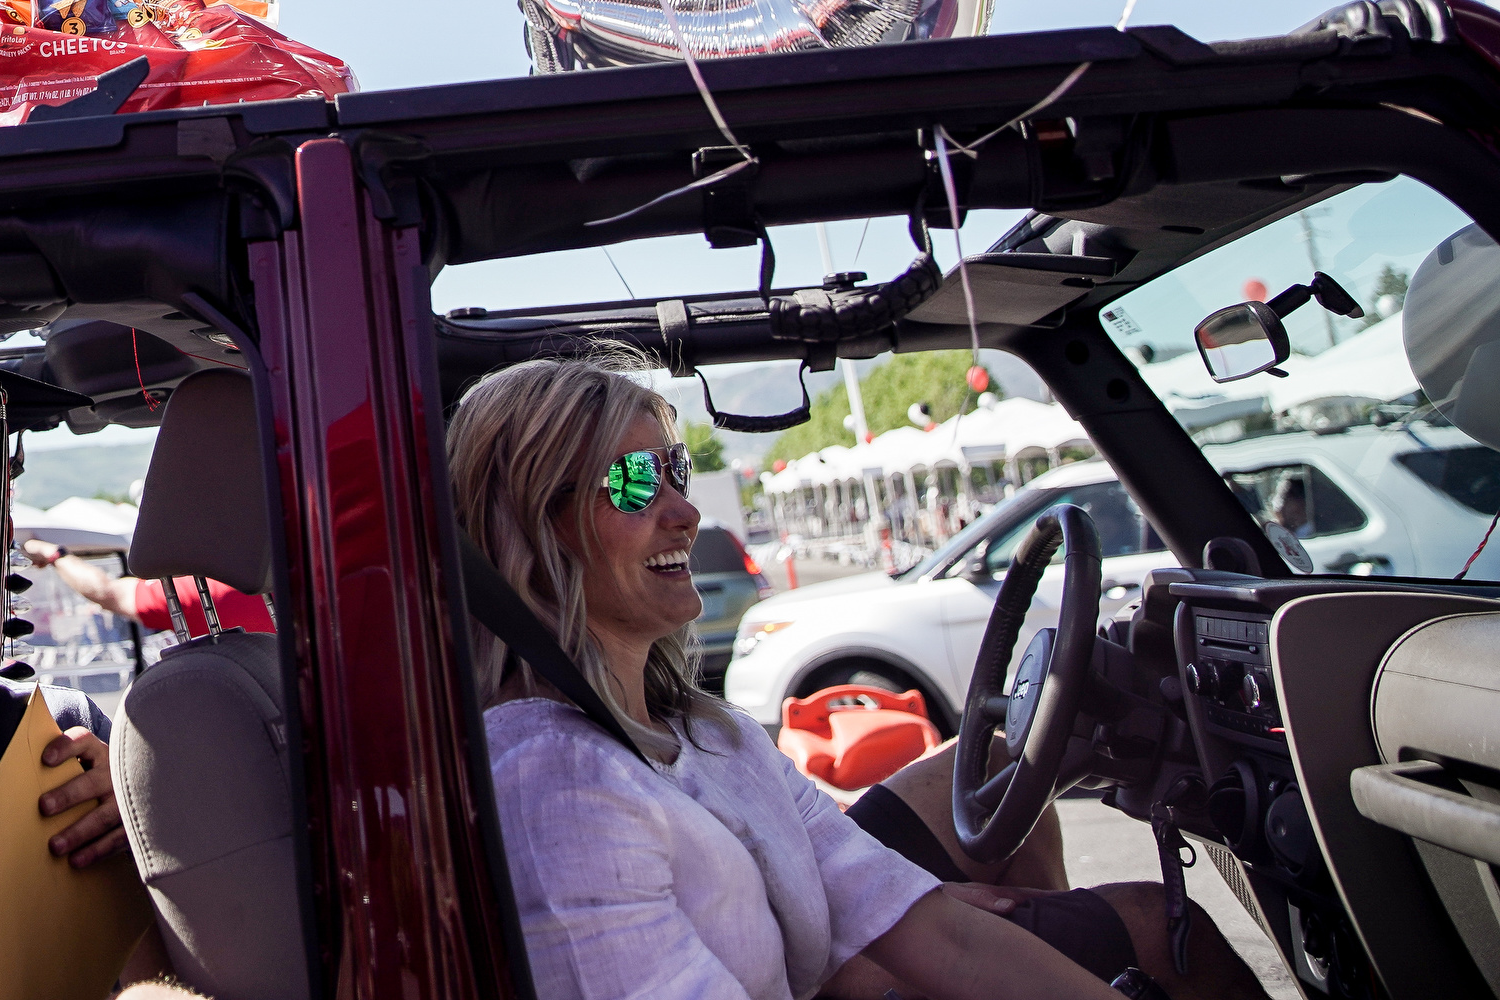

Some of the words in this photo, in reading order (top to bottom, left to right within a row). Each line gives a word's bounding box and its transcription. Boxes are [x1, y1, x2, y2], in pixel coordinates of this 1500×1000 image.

[134, 11, 144, 23] 3
[68, 22, 79, 36] 3
[39, 37, 128, 58] CHEETOS
